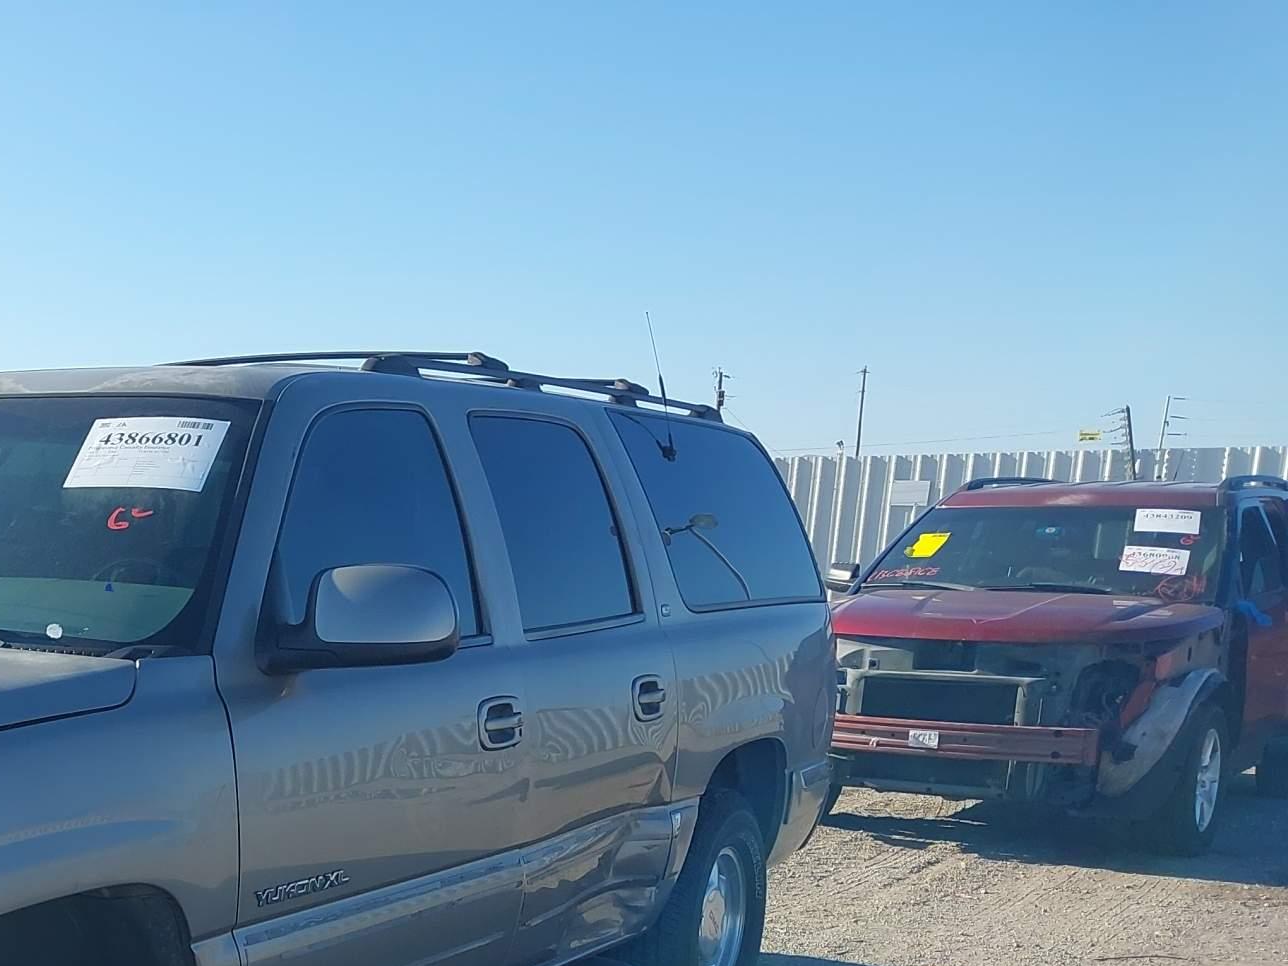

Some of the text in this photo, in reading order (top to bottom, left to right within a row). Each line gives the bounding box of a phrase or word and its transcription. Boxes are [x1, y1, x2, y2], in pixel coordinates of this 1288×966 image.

[99, 431, 203, 447] 43866801
[255, 868, 350, 908] YUKON XL
